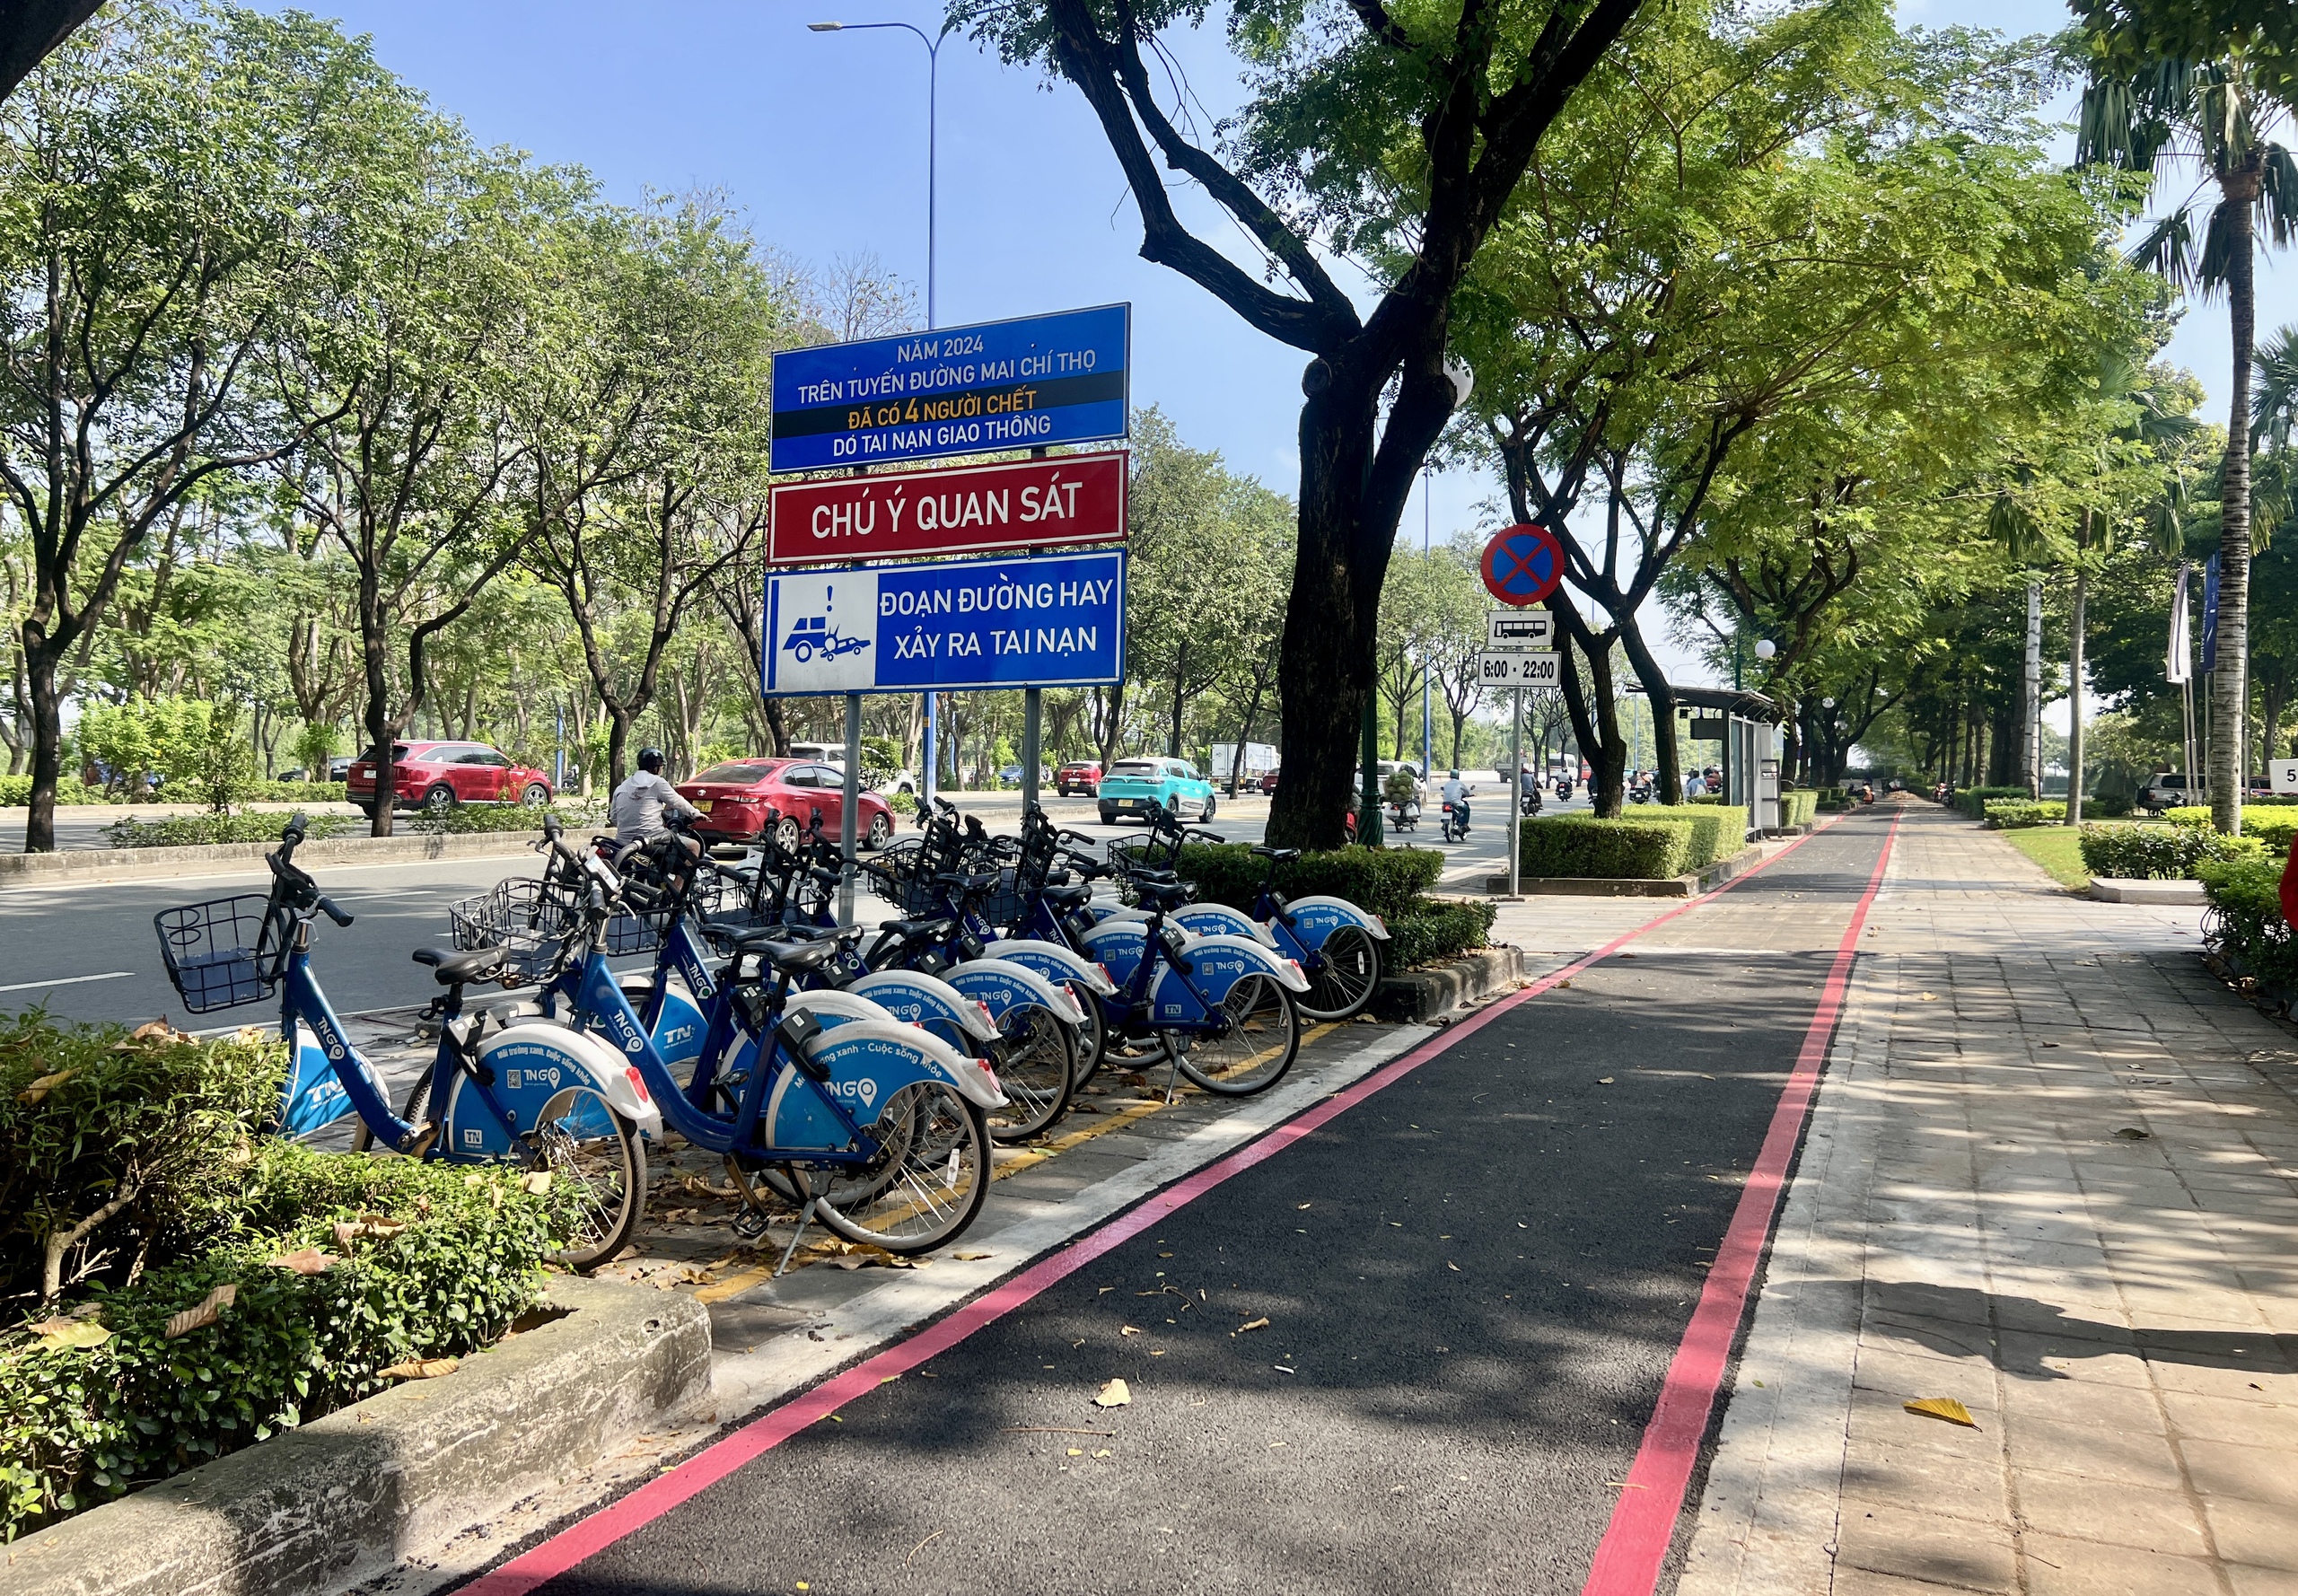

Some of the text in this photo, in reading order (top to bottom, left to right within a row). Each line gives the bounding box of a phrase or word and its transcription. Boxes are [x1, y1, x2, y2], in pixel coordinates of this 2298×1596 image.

[898, 335, 984, 363] NĂM 2024
[798, 349, 1096, 404] TRÊN TUYẾN ĐƯỜNG MAI CHÍ THỌ
[848, 384, 1037, 429] ĐÃ CÓ 4 NGƯỜI CHẾT
[862, 433, 887, 453] TAI
[892, 428, 932, 452] NẠN
[937, 423, 980, 446] GIAO
[985, 415, 1051, 440] THÔNG
[811, 470, 1083, 539] CHÚ Ý QUAN SÁT
[880, 573, 1114, 618] ĐOẠN ĐƯỜNG HAY
[894, 625, 1097, 660] XẢY RA TAI NẠN
[1484, 660, 1508, 679] 6:00
[1522, 660, 1554, 680] 22:00
[2286, 768, 2297, 783] 5
[974, 913, 991, 934] NGO
[318, 1016, 345, 1060] TNGO
[614, 1008, 644, 1052] TNGO
[664, 1024, 691, 1044] TN
[838, 1045, 859, 1057] xanh
[867, 1042, 893, 1056] Cuộc
[524, 1067, 561, 1089] TNGO
